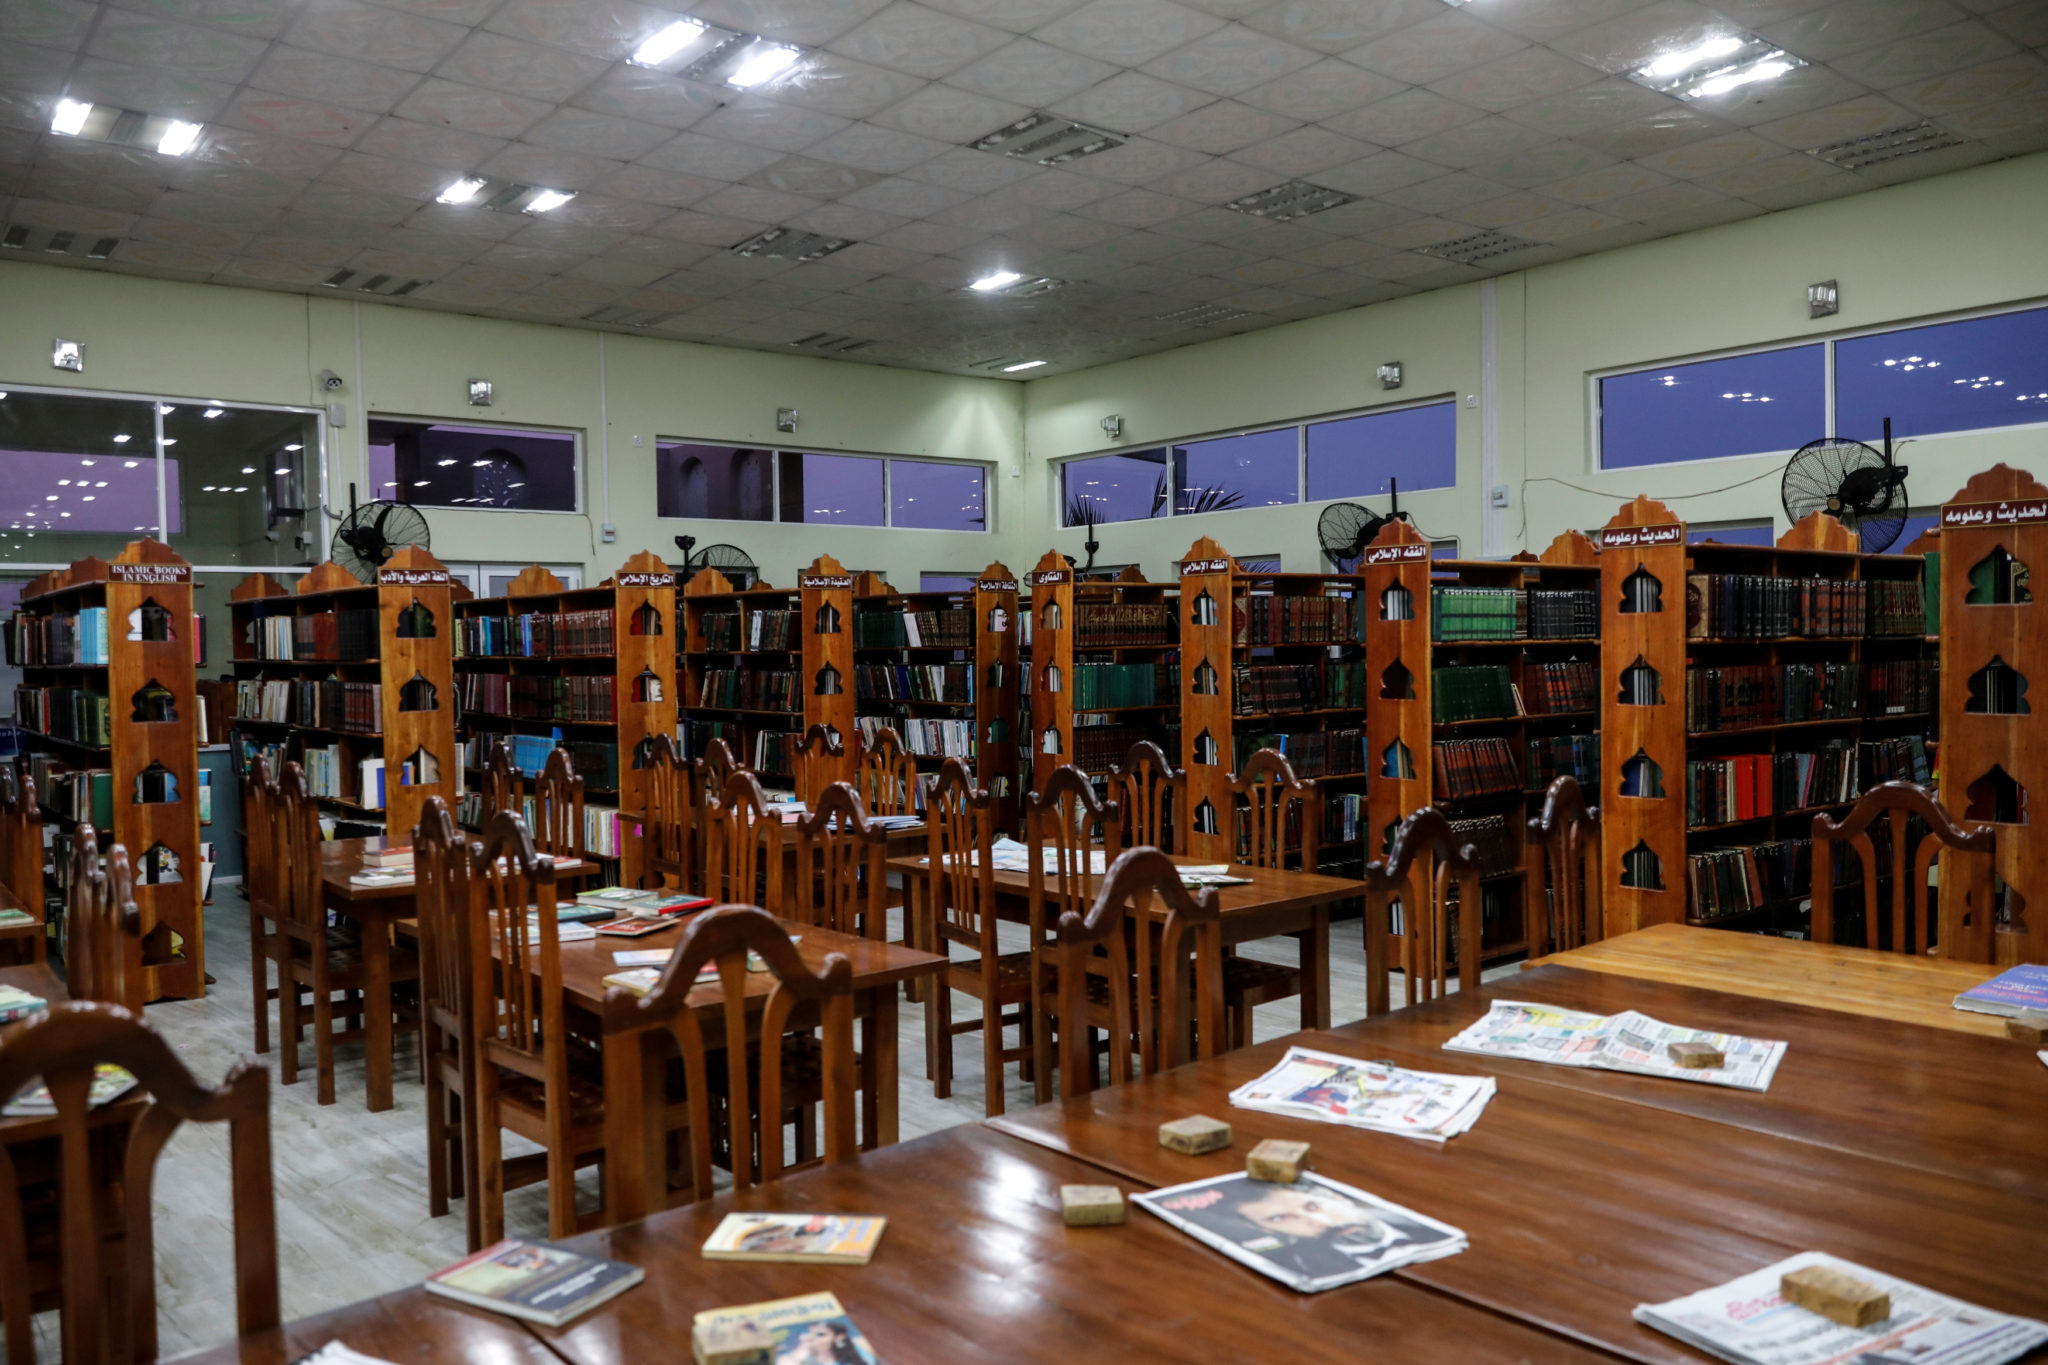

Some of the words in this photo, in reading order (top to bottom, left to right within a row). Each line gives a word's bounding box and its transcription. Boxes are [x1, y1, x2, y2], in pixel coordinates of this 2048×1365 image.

[1945, 508, 1992, 524] وعلومه
[1996, 502, 2048, 522] لحديث
[1604, 532, 1637, 545] وعلومه
[1640, 527, 1679, 543] الحديث
[1403, 545, 1426, 556] الفقه
[112, 565, 152, 574] ISLAMIC
[154, 565, 187, 575] BOOKS
[1210, 559, 1227, 569] الفقه
[136, 574, 176, 582] ENGLISH
[381, 570, 403, 583] والأدب
[405, 570, 430, 583] العربية
[432, 570, 447, 581] اللغة
[650, 573, 673, 585] التاريخ
